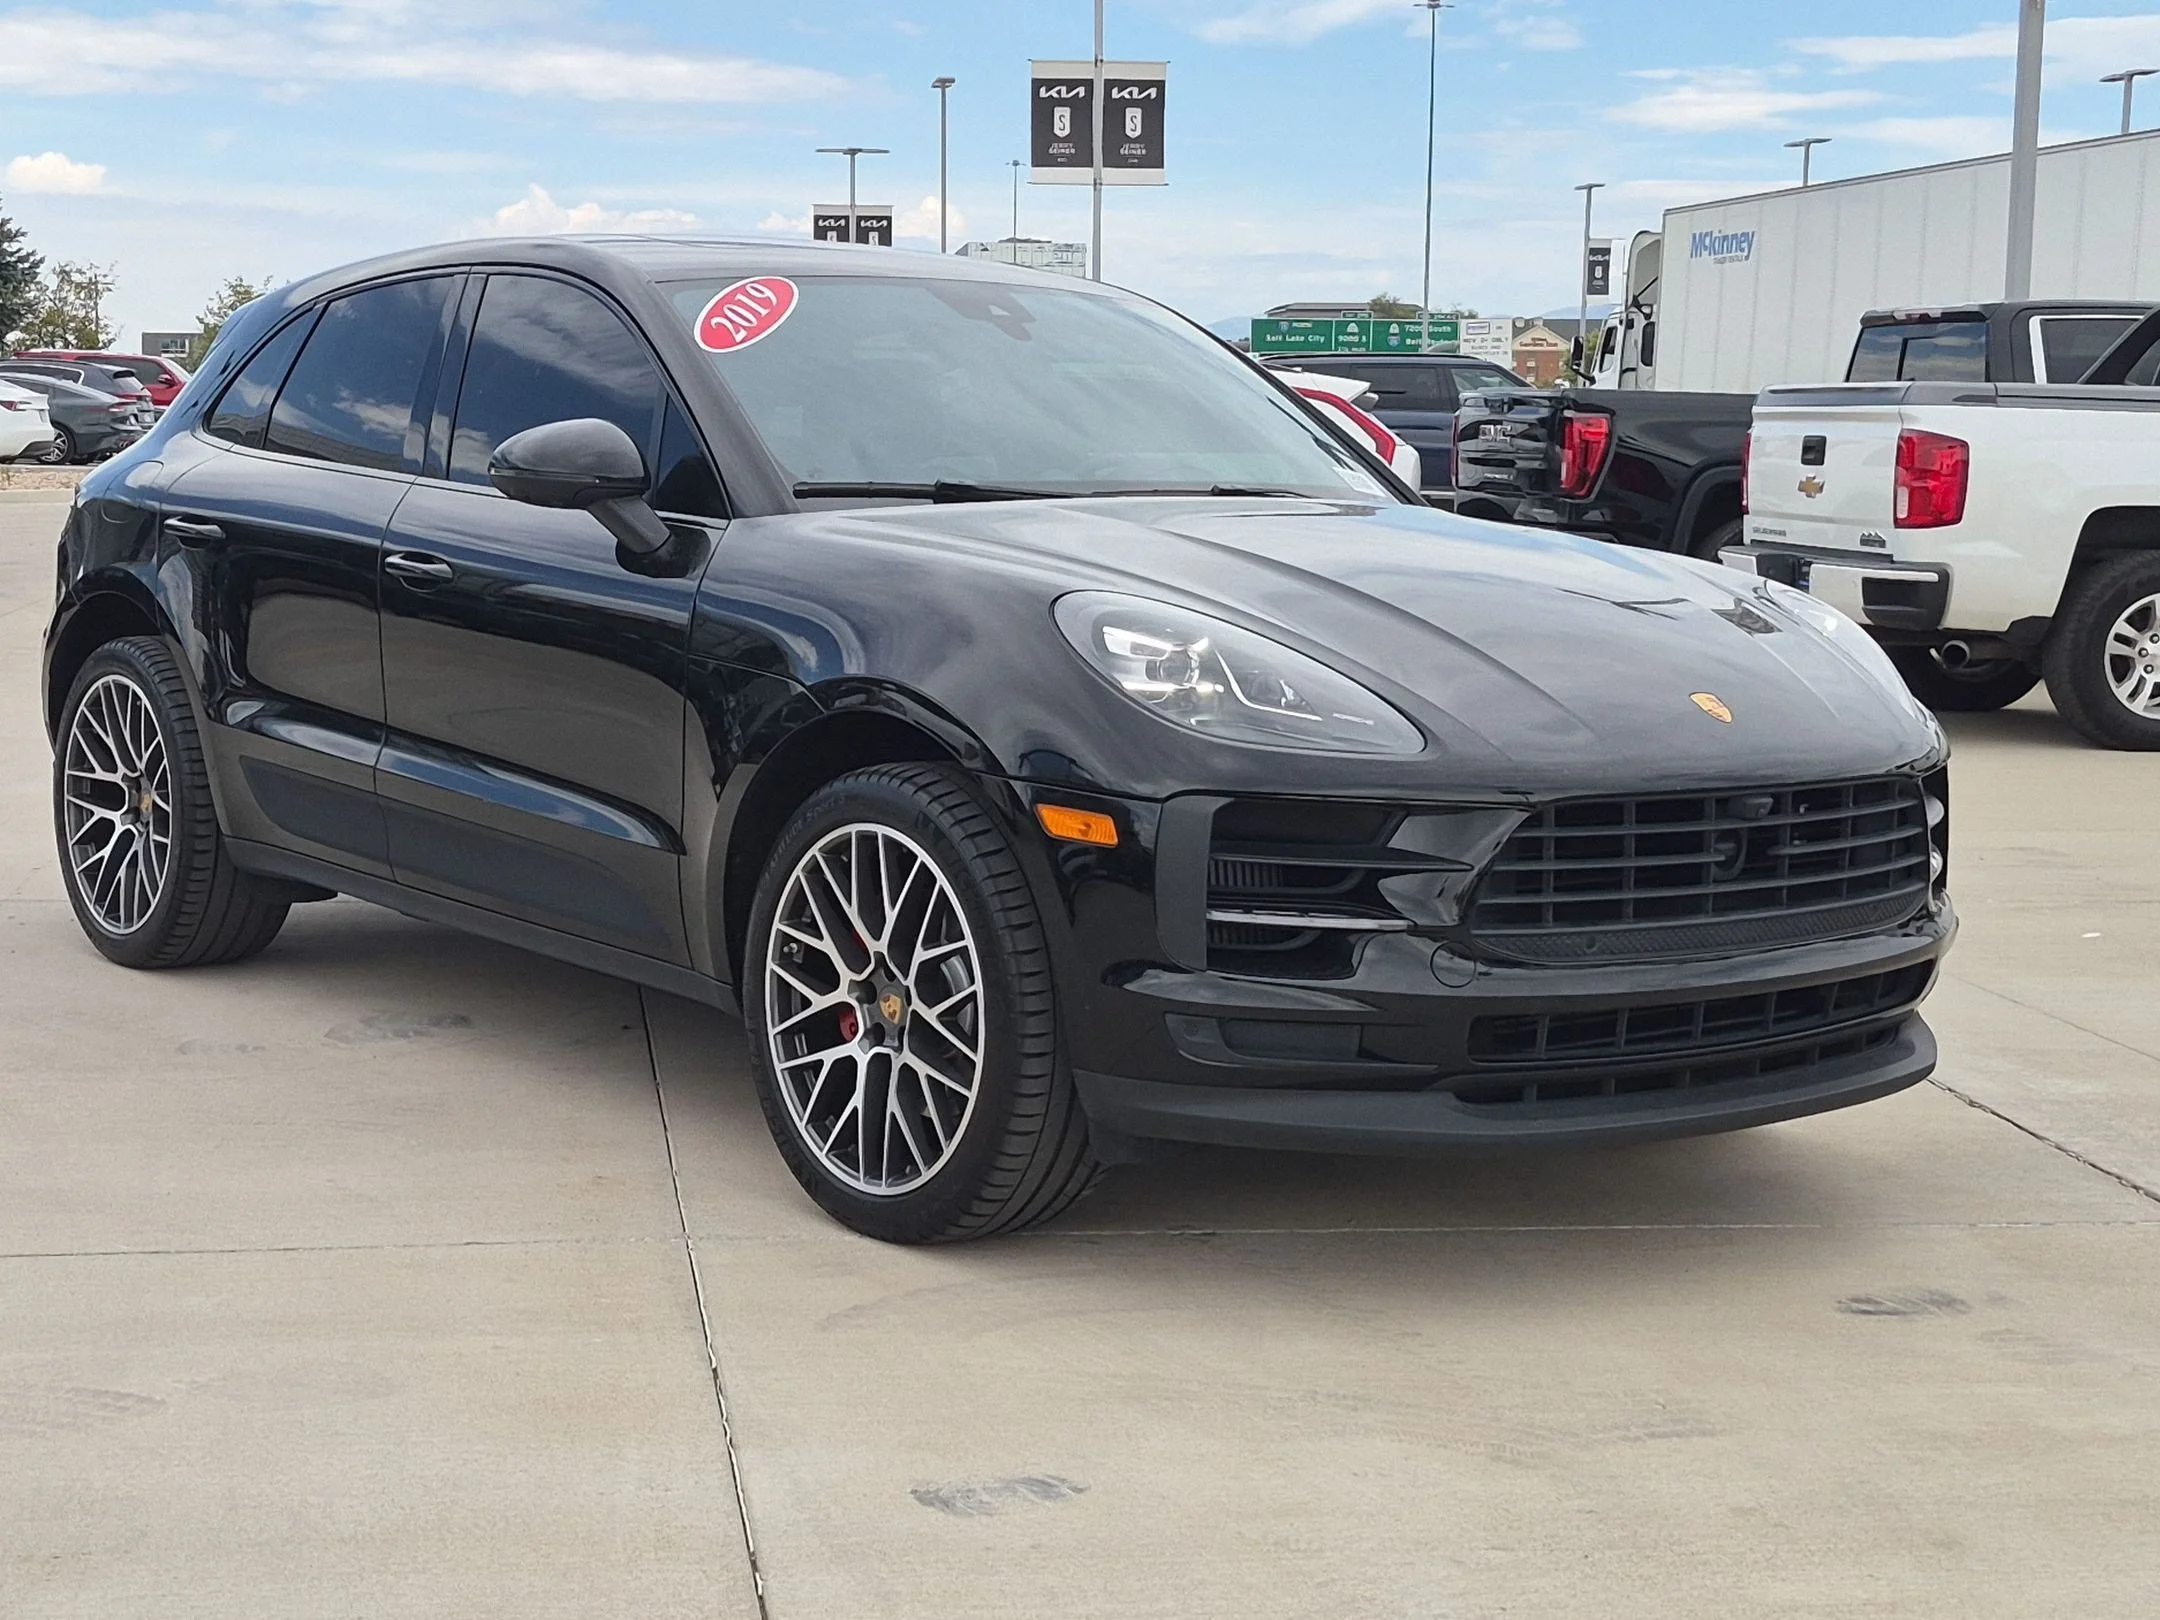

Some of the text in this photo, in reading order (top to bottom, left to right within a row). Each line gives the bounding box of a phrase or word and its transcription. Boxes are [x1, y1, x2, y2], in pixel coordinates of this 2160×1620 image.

[1039, 85, 1086, 98] KIA
[1111, 86, 1158, 99] KIA
[710, 282, 778, 343] 2019
[1308, 334, 1325, 344] City
